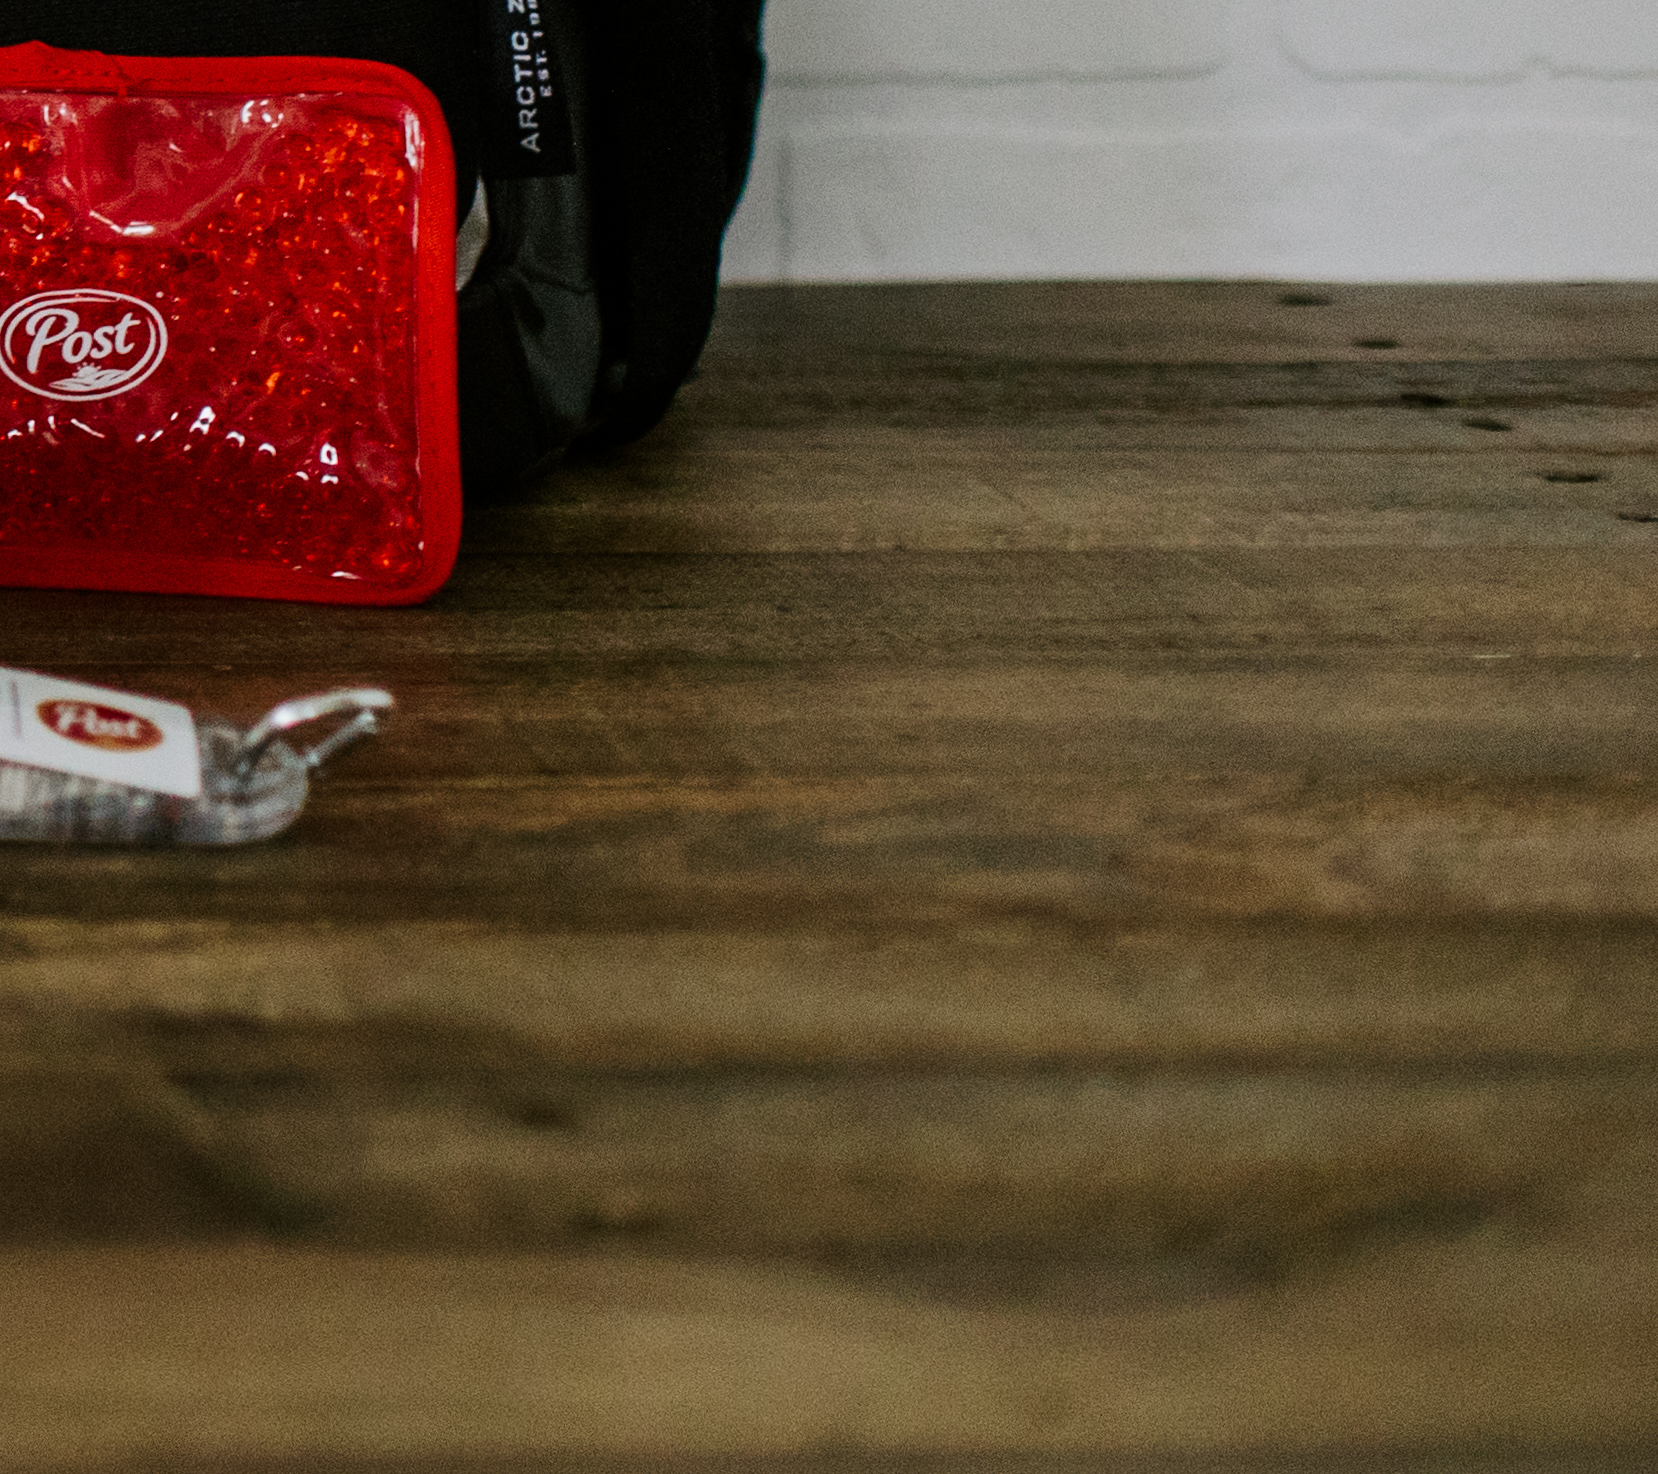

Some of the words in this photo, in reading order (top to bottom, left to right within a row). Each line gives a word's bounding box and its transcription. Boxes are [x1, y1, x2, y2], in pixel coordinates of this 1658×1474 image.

[511, 31, 541, 153] ARCTIC
[535, 50, 552, 98] EST.
[26, 308, 141, 375] Post
